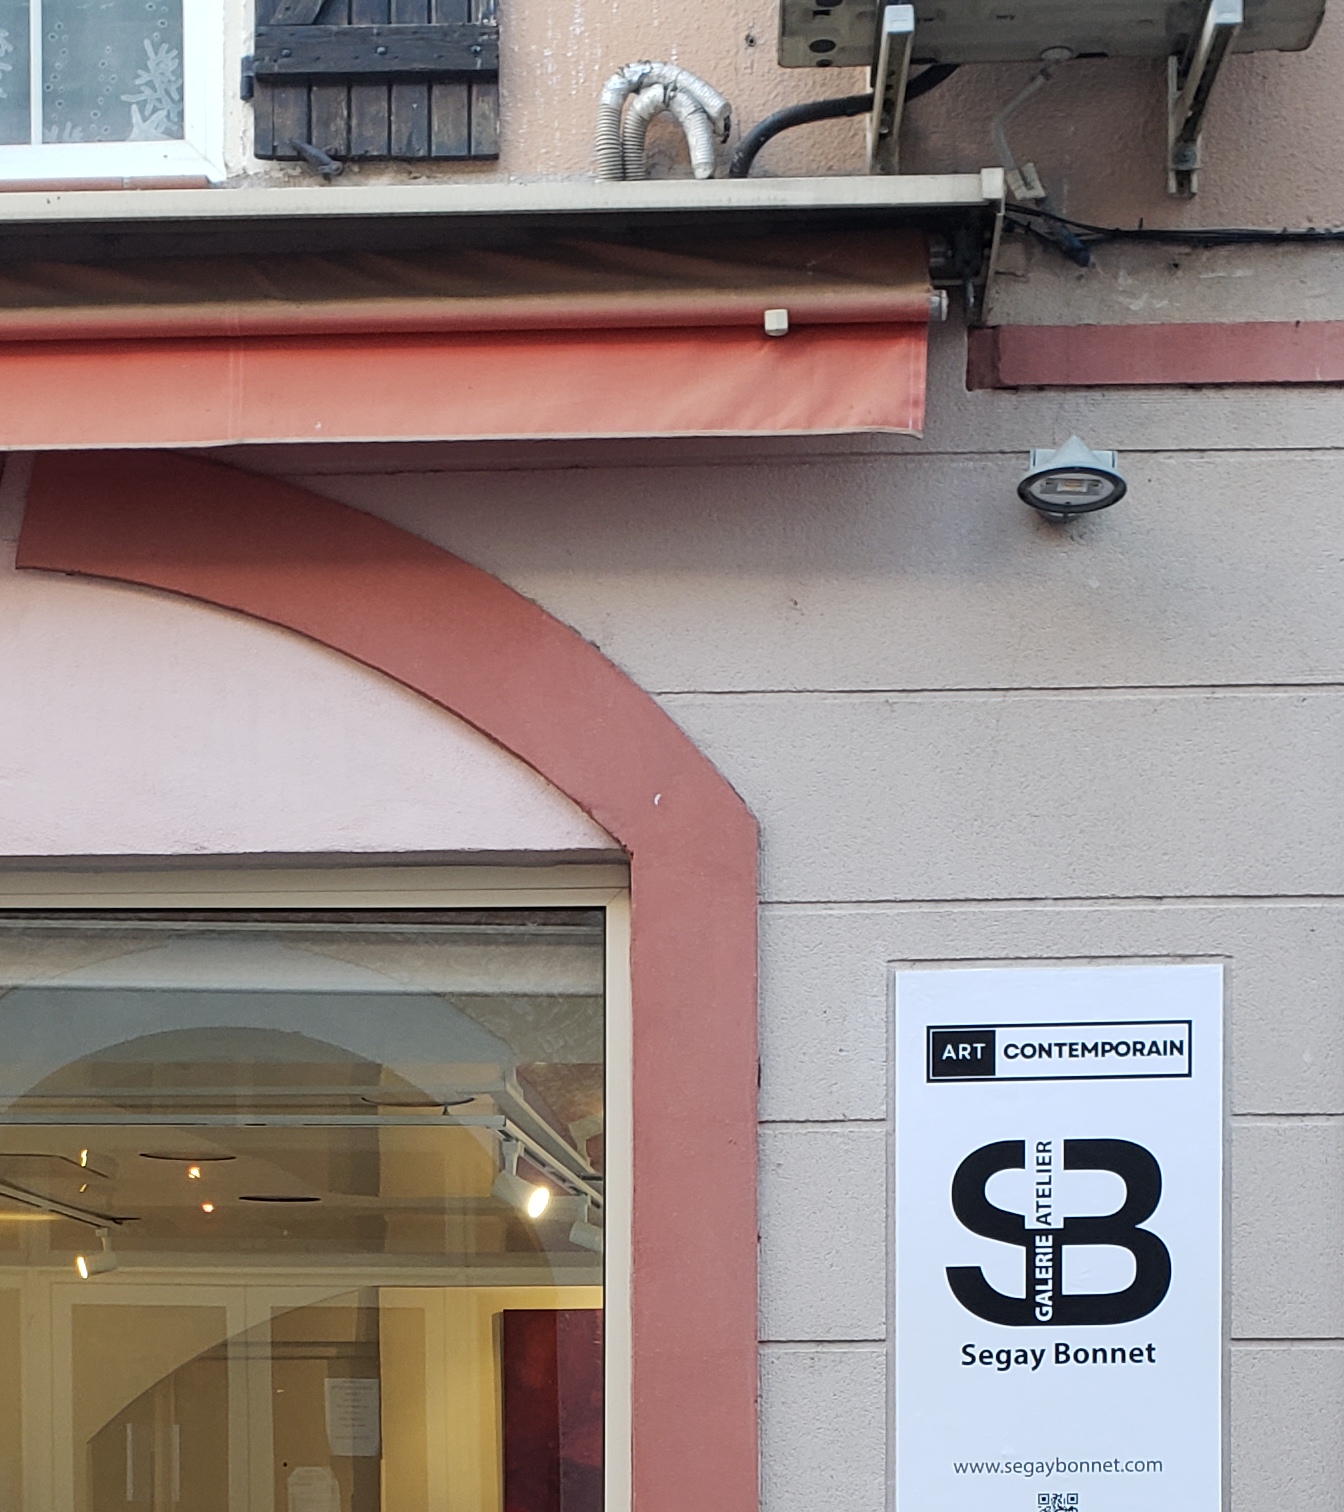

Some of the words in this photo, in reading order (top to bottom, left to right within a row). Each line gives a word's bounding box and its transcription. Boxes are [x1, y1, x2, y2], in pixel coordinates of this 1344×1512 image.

[942, 1043, 986, 1060] ART
[1003, 1039, 1184, 1060] CONTEMPORAIN
[1035, 1140, 1053, 1227] ATELIER
[1034, 1234, 1053, 1322] GALERIE
[961, 1343, 1046, 1371] Segay
[1054, 1342, 1156, 1364] Bonnet
[953, 1457, 1163, 1477] www.segaybonnet.com
